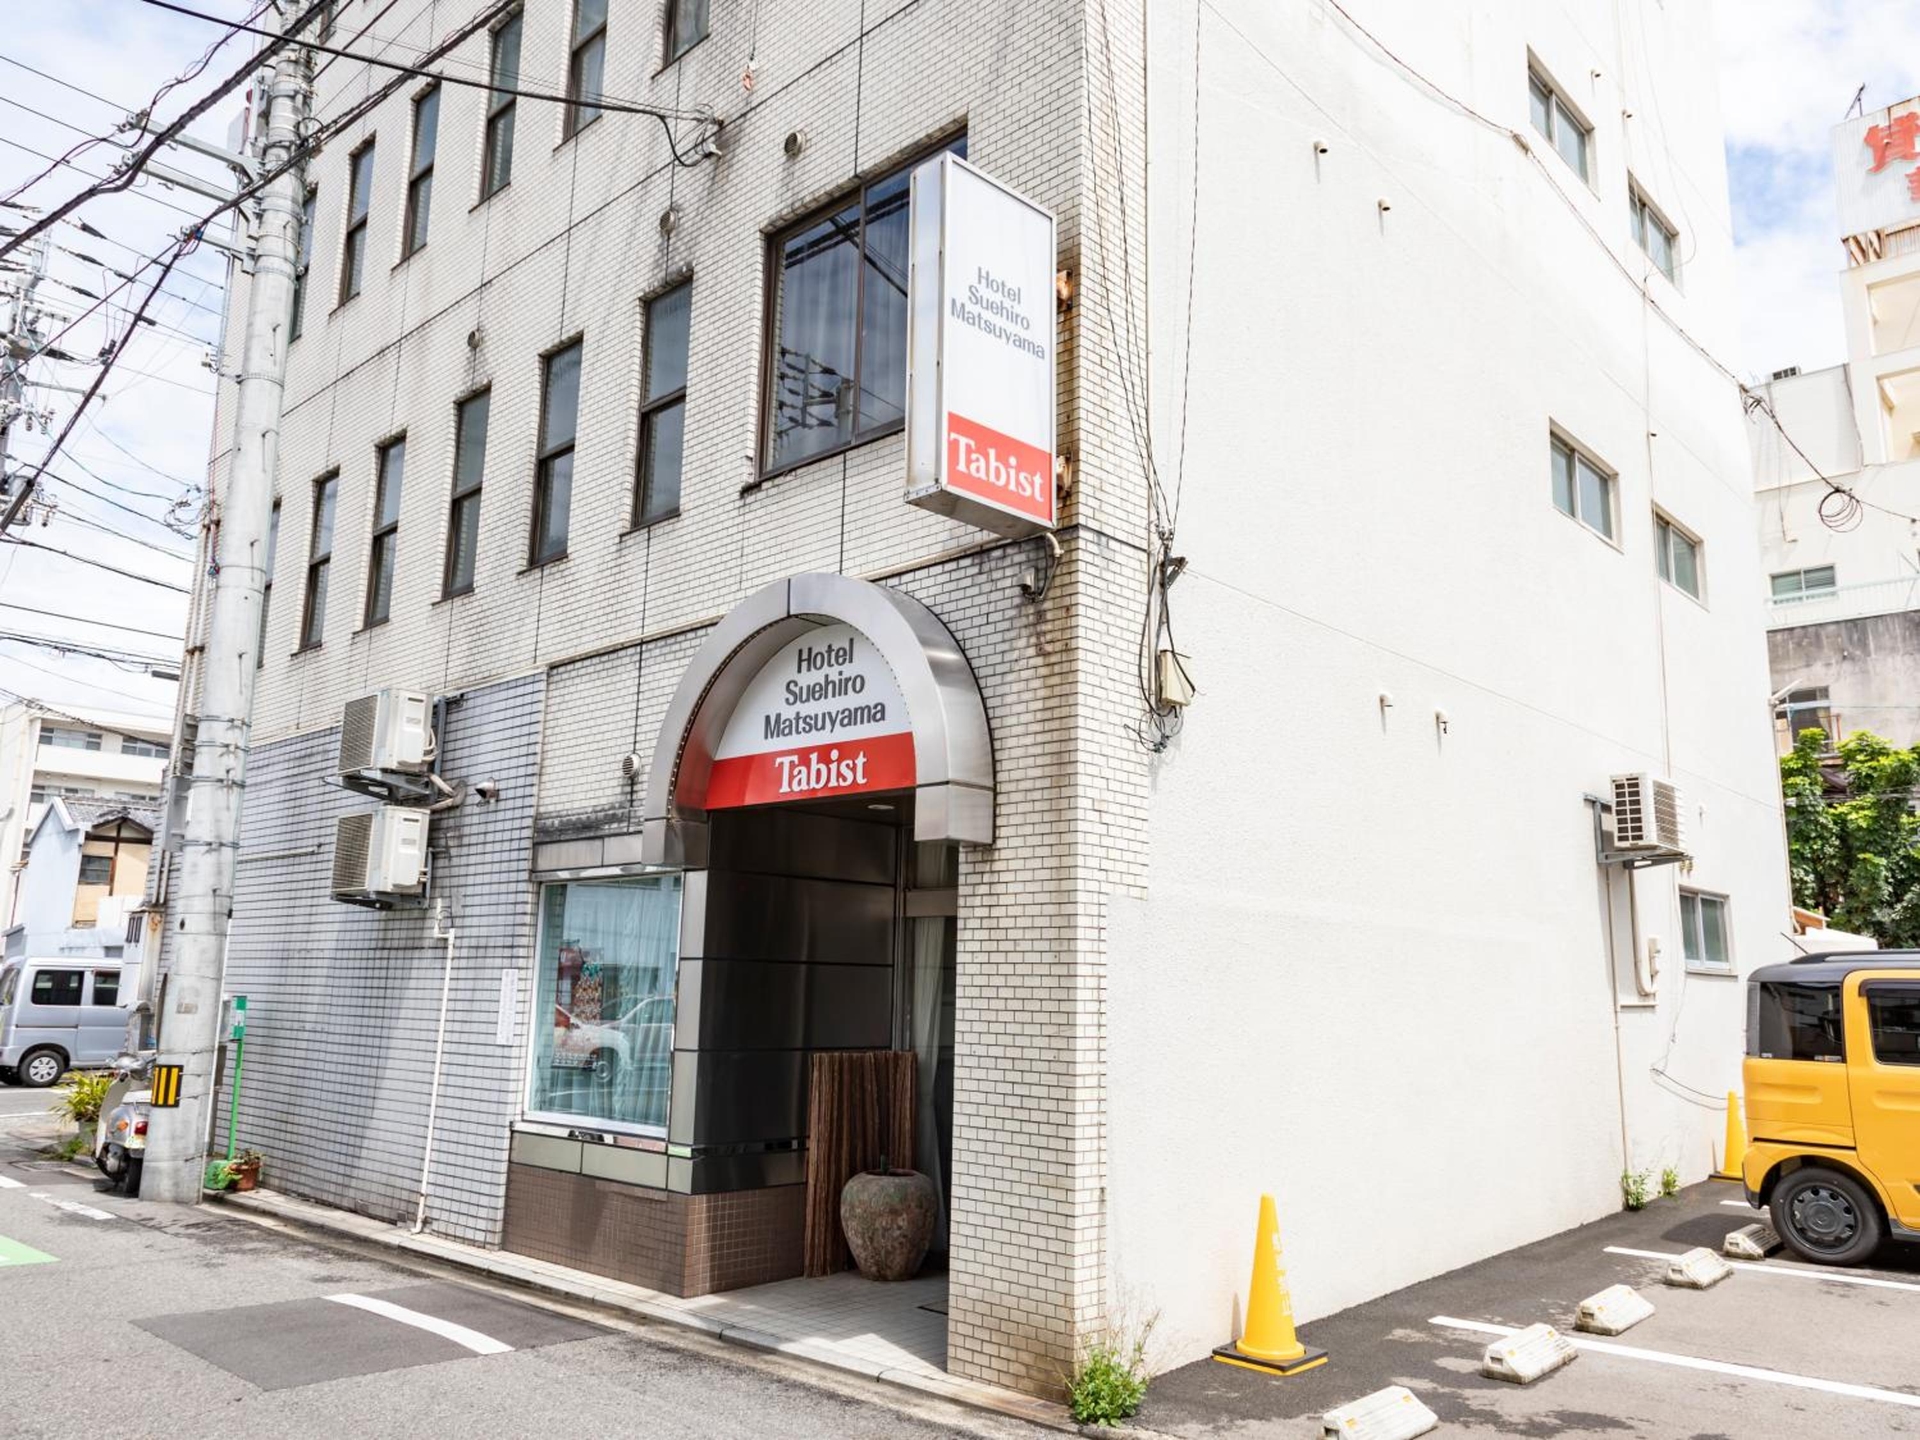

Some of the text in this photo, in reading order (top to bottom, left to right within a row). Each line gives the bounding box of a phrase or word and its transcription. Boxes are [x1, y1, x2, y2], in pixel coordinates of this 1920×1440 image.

[977, 266, 1021, 305] Hotel
[968, 285, 1030, 330] Suehiro
[951, 298, 1045, 360] Matsuyama
[950, 431, 1044, 503] Tabist
[797, 638, 854, 674] Hotel
[785, 671, 865, 706] Suehiro
[764, 702, 885, 740] Matsuyama
[775, 749, 867, 793] Tabist
